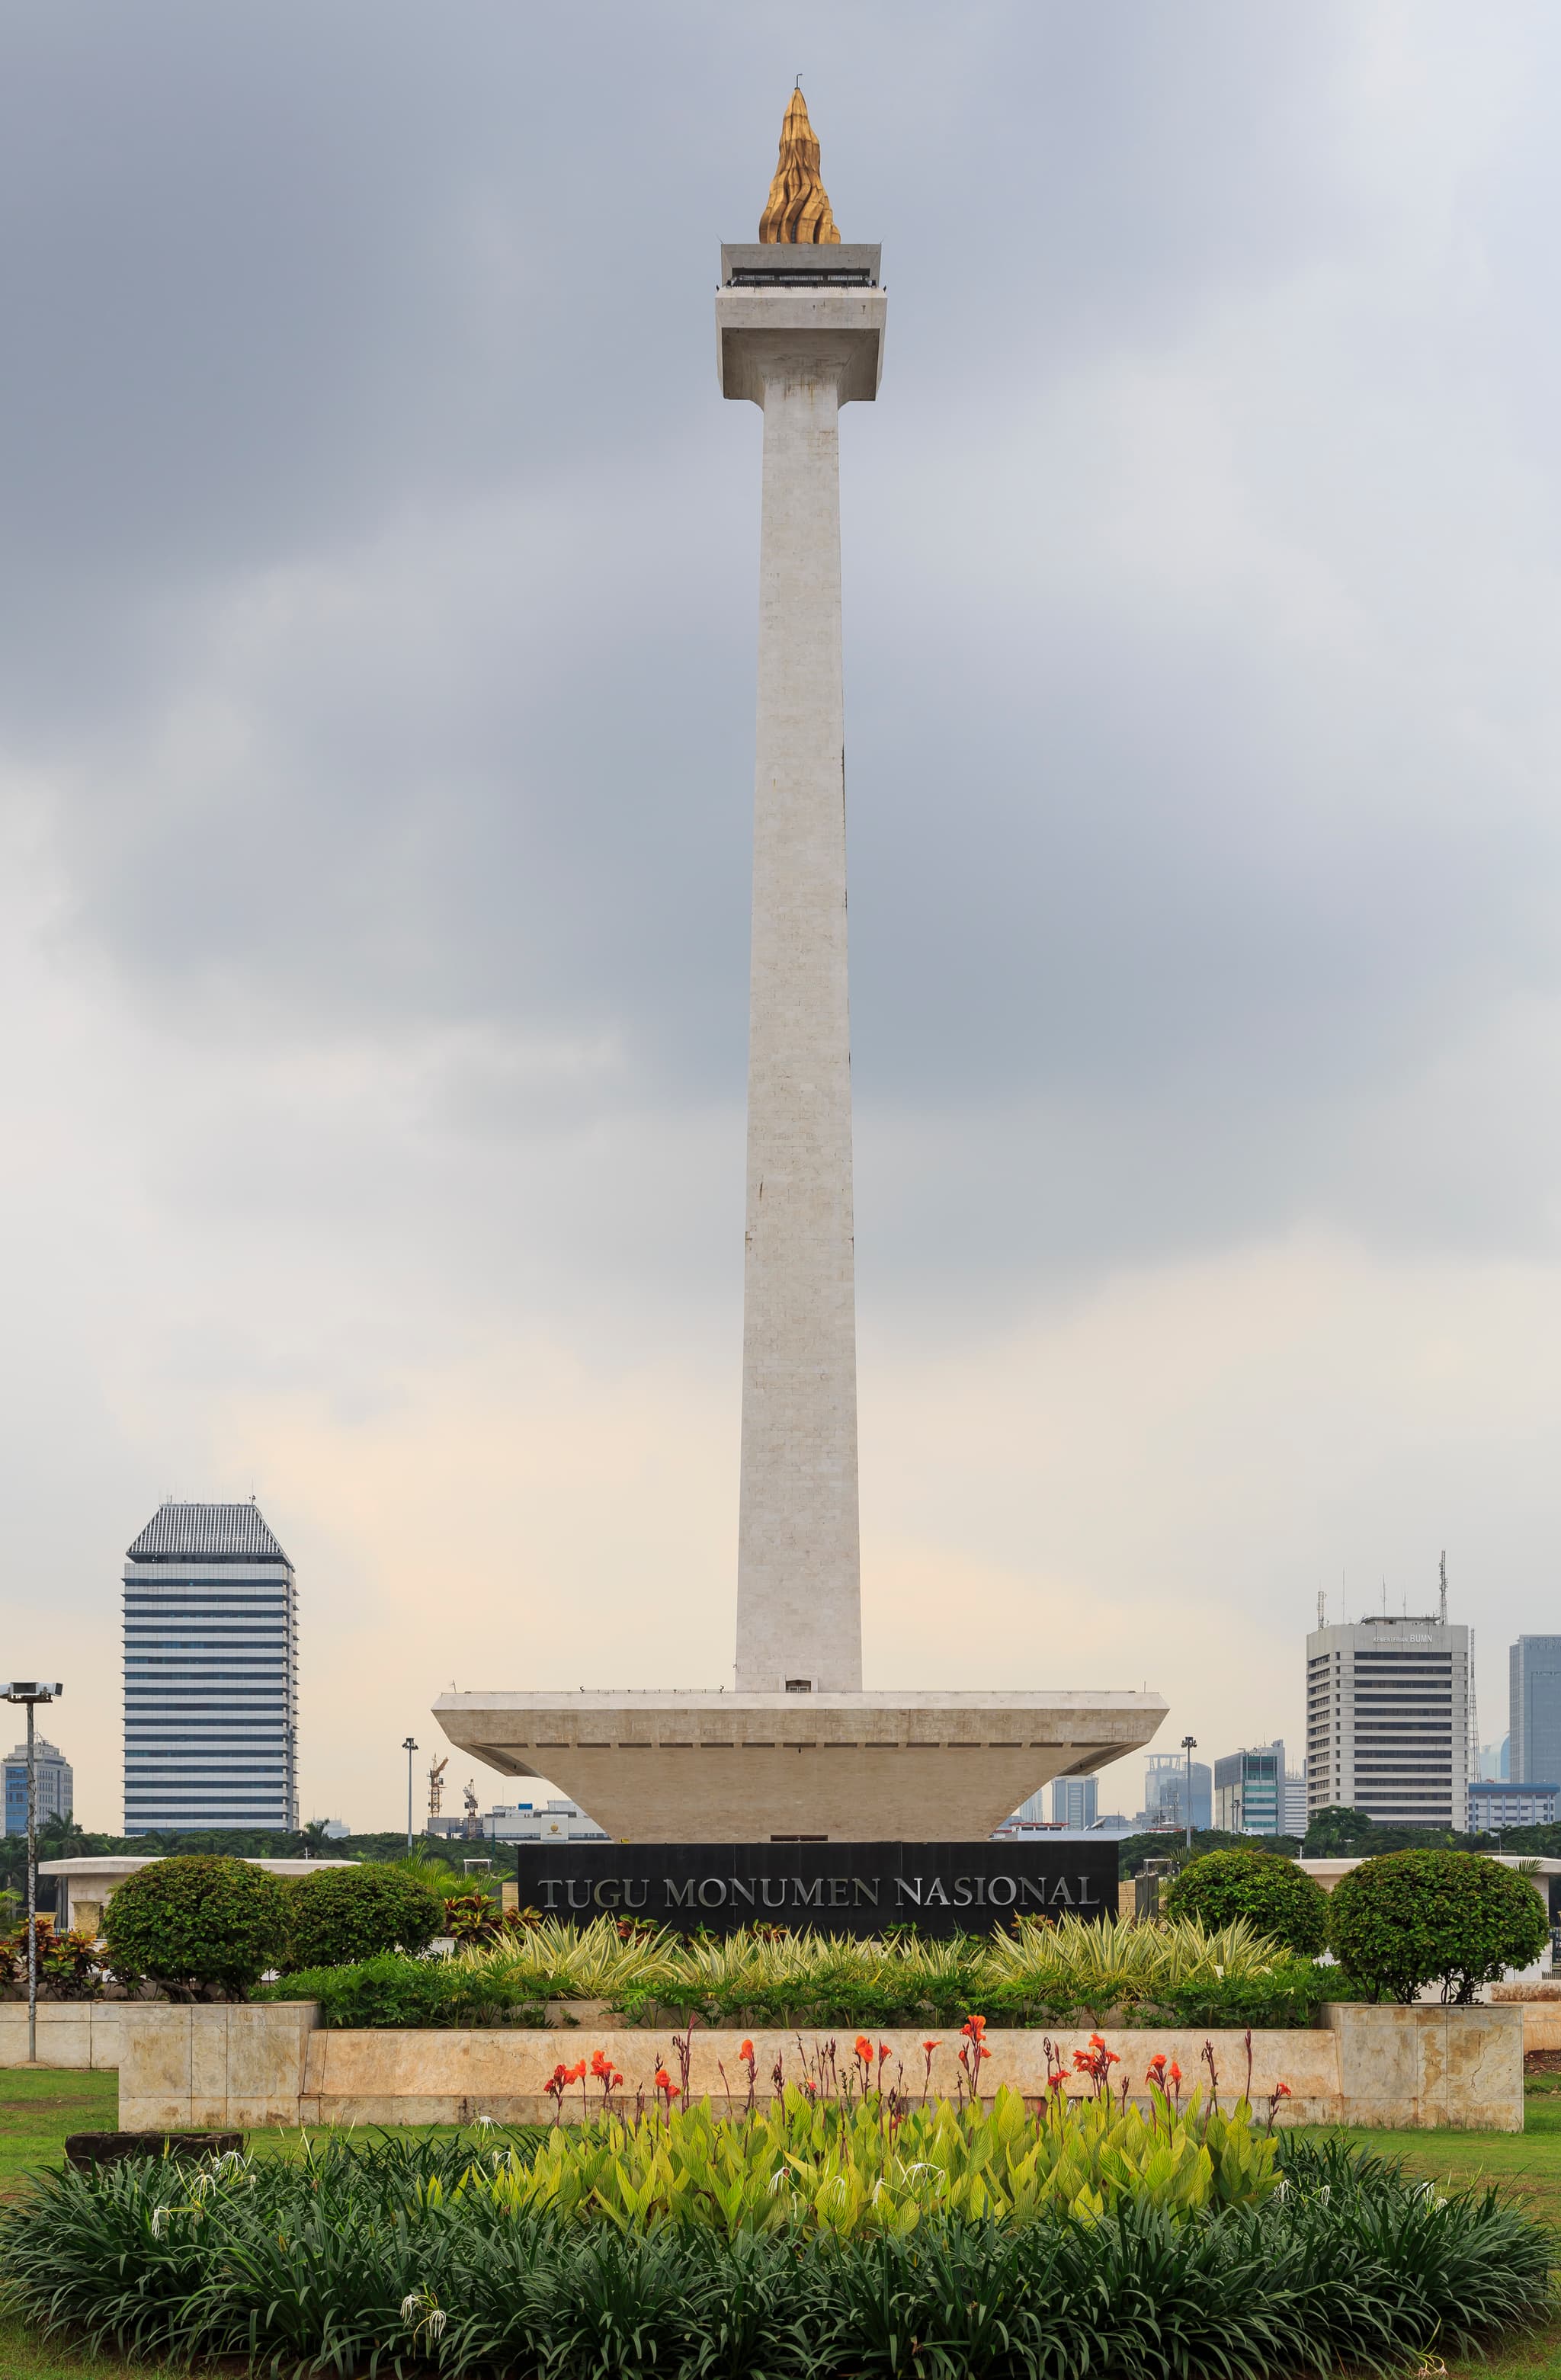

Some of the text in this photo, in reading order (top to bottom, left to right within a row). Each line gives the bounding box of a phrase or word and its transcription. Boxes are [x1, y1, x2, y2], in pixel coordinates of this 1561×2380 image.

[1409, 1634, 1433, 1643] BUMN
[537, 1876, 1100, 1908] TUGU MONUMEN NASIONAL
